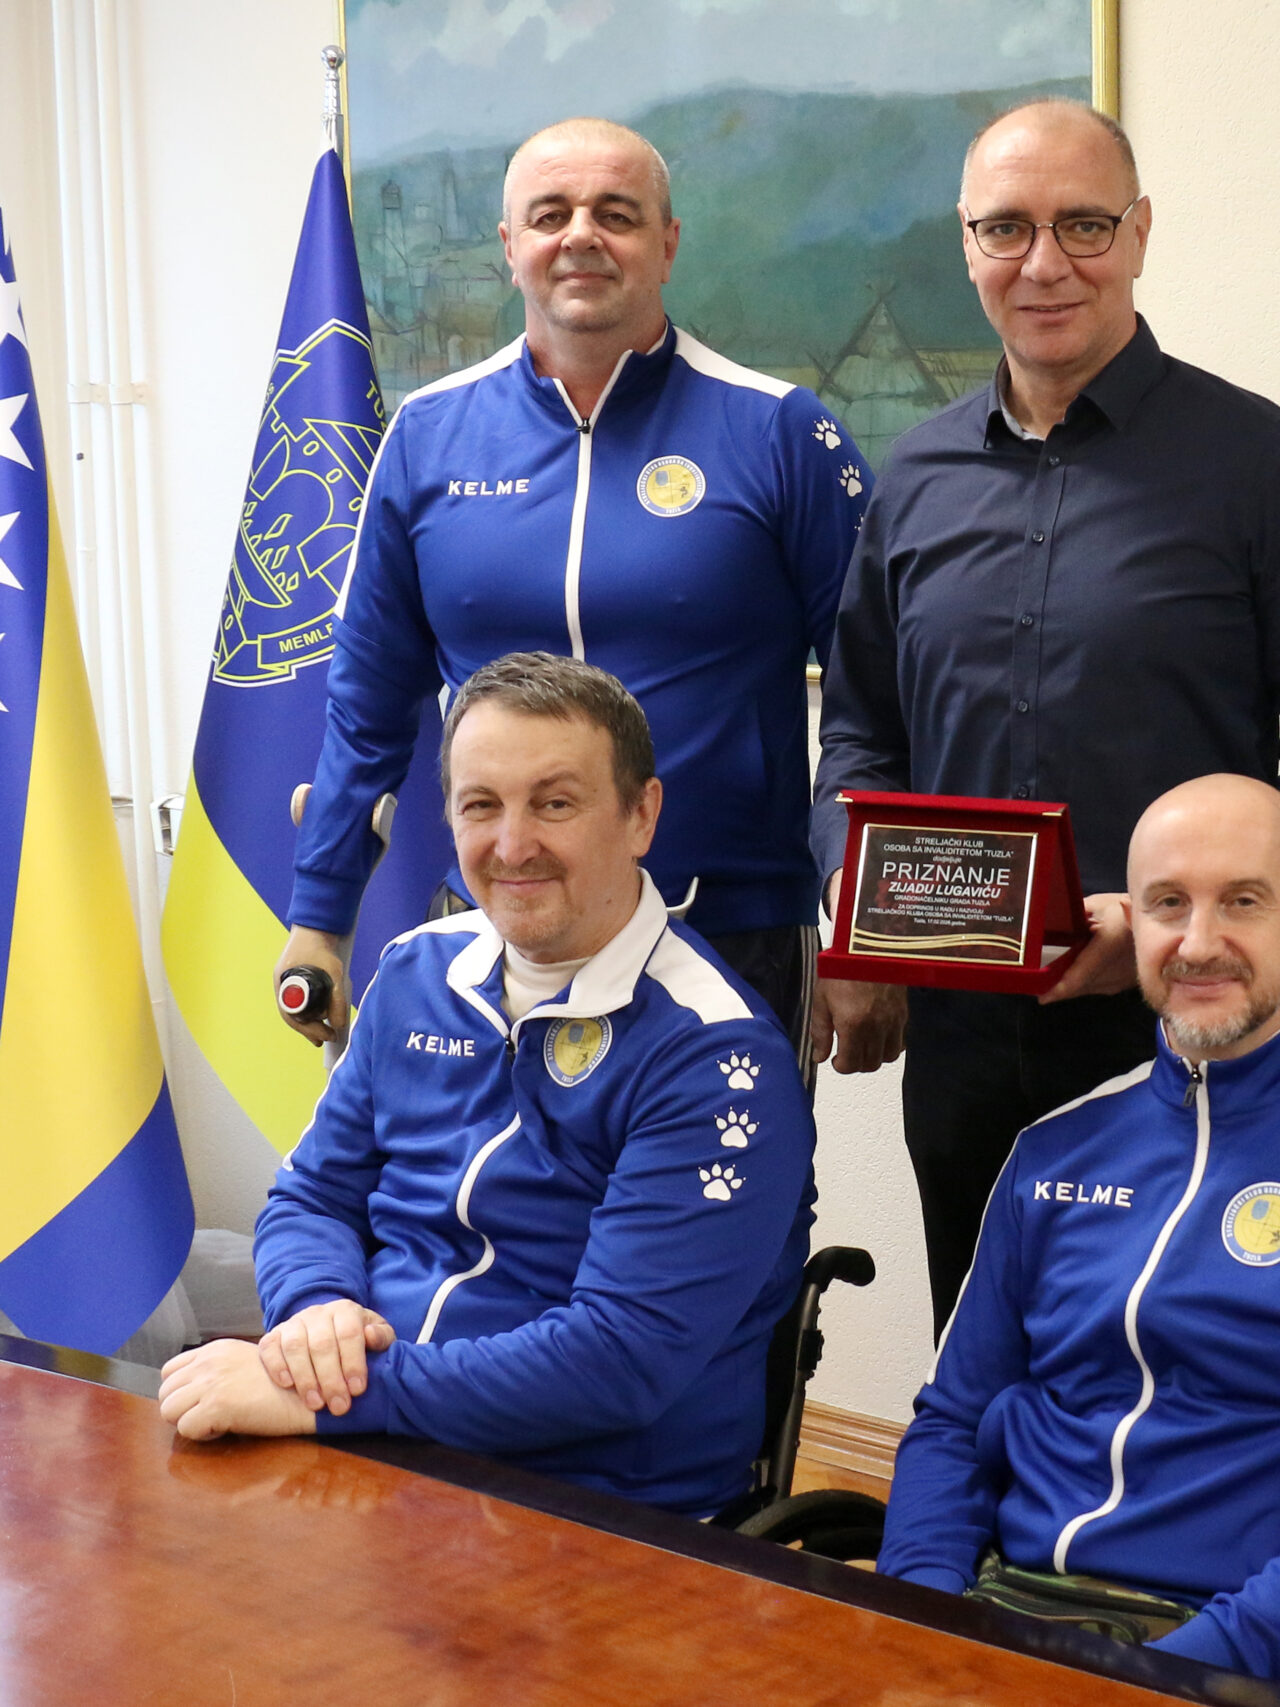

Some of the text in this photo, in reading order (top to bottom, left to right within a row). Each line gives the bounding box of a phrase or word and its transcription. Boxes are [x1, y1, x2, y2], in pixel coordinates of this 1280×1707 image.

[448, 478, 530, 496] KELME
[883, 843, 1014, 858] OSOBA SA INVALIDITETOM "TUZLA"
[915, 837, 984, 848] STRELJAČKI KLUB
[882, 861, 1011, 886] PRIZNANJE
[888, 881, 1001, 898] ZIJADU LUGAVIĆU
[406, 1031, 475, 1057] KELME
[1034, 1181, 1134, 1208] KELME
